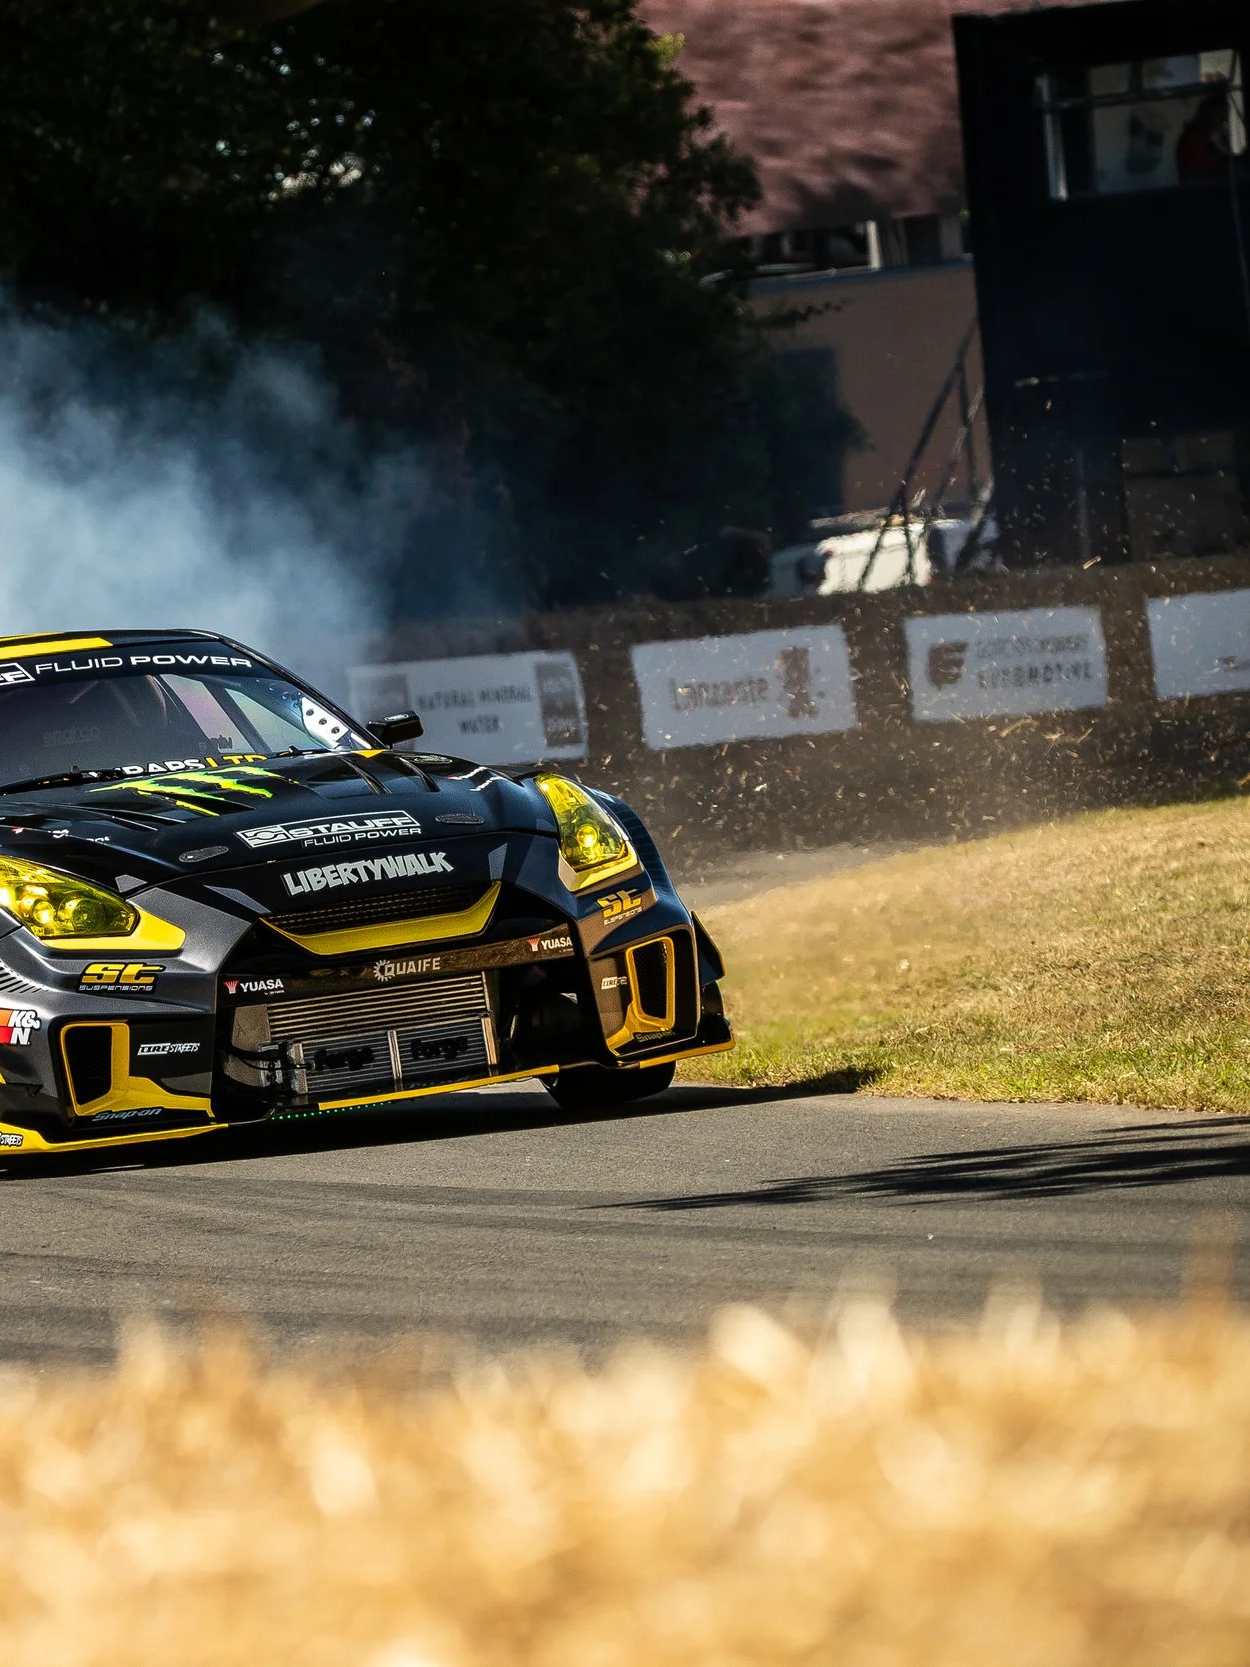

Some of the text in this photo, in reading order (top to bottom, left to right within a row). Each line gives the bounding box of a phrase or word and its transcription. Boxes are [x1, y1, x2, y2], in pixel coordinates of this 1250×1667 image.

[35, 657, 123, 675] FLUID
[130, 655, 252, 668] POWER
[288, 815, 414, 838] STAUFF
[304, 827, 421, 847] FLUID POWER
[283, 851, 454, 896] LIBERTYWALK
[540, 936, 573, 950] YUASA
[380, 956, 441, 978] QUAIFE
[240, 978, 284, 993] YUASA
[92, 1108, 162, 1122] Snap-on
